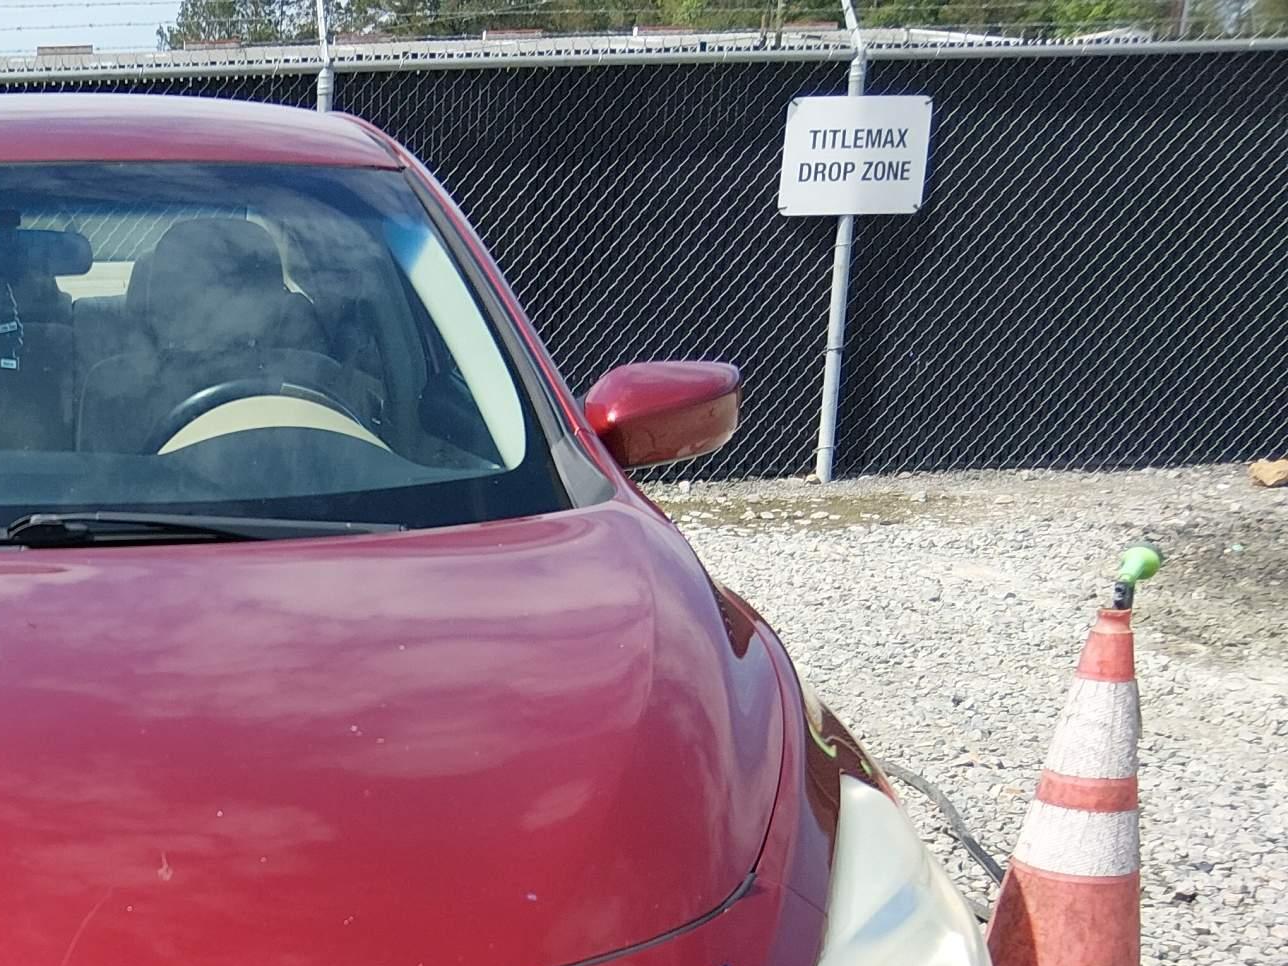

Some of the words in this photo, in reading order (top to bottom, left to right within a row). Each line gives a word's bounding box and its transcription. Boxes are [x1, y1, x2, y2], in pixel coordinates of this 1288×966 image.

[809, 128, 909, 150] TITLEMAX
[798, 162, 856, 182] DROP
[861, 161, 912, 181] ZONE
